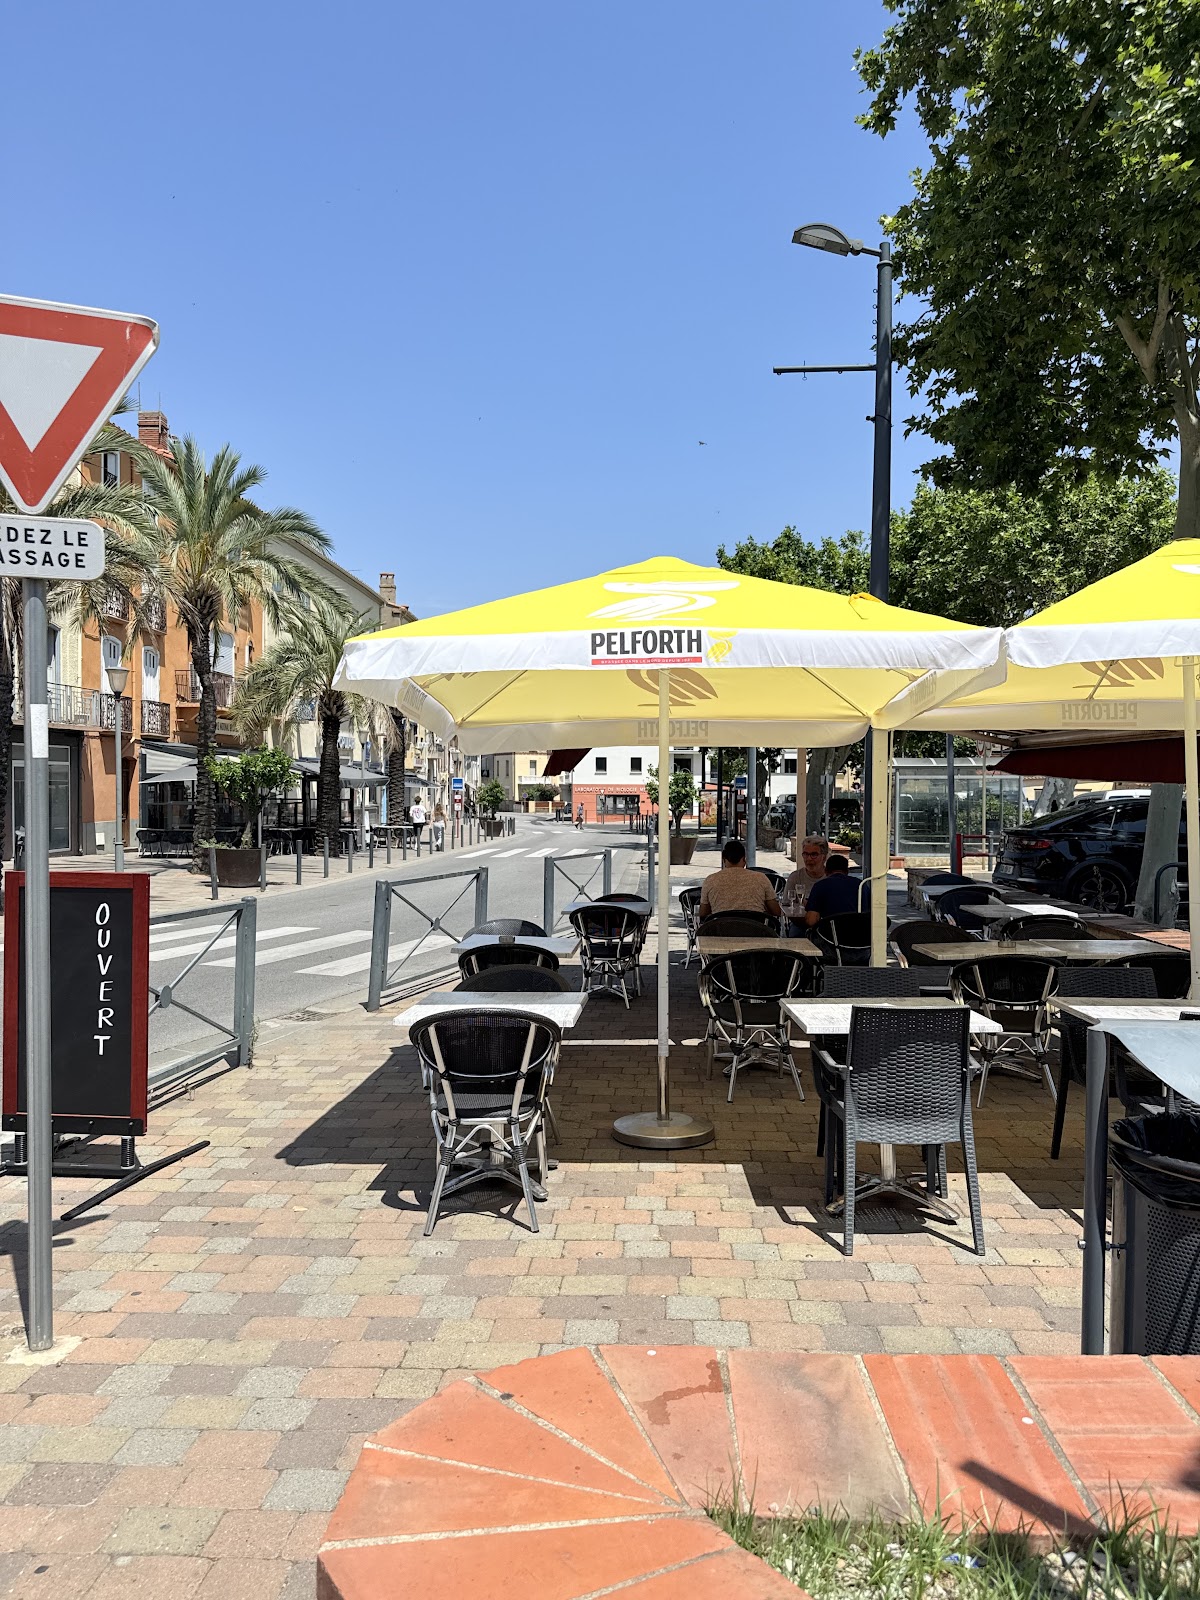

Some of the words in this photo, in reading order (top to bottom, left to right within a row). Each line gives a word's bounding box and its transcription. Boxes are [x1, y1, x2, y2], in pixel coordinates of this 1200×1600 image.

[0, 526, 52, 545] DEZ
[63, 530, 89, 547] LE
[591, 629, 702, 656] PELFORTH
[93, 902, 115, 1056] OUVERT
